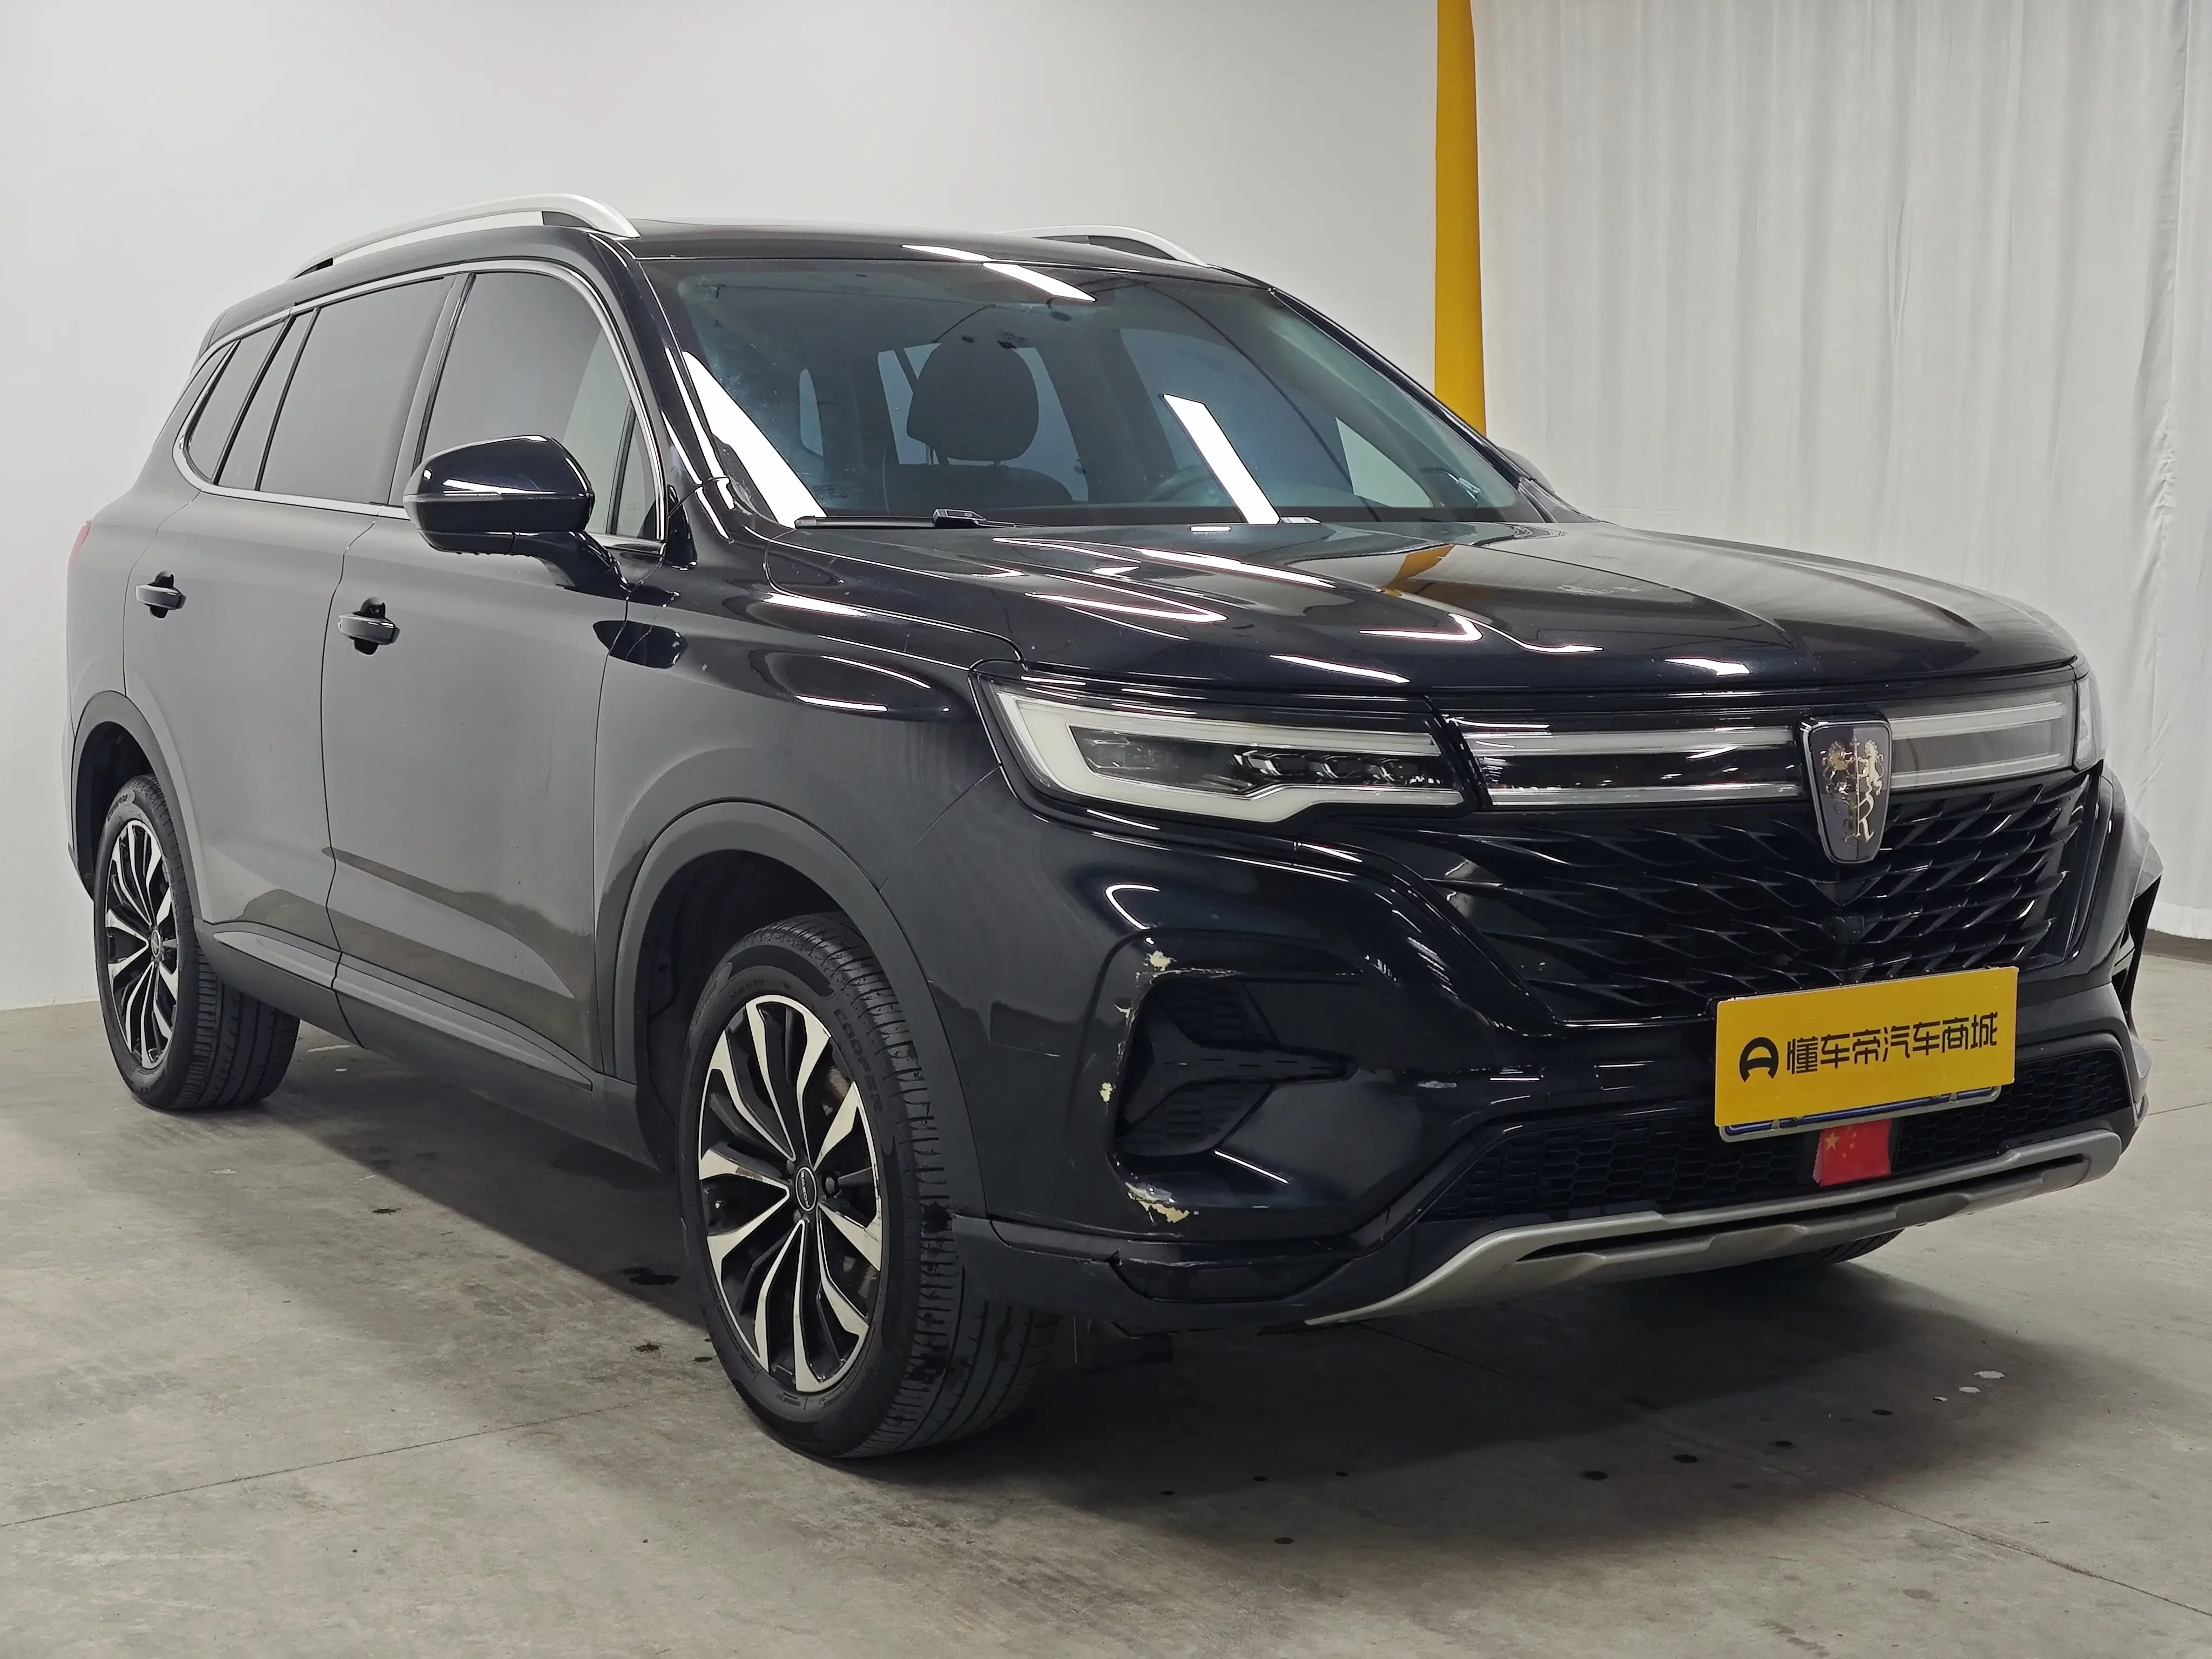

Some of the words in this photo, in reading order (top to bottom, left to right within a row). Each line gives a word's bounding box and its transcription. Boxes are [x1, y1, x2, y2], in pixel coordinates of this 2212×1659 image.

[1786, 1011, 1998, 1075] 懂车帝汽车商城
